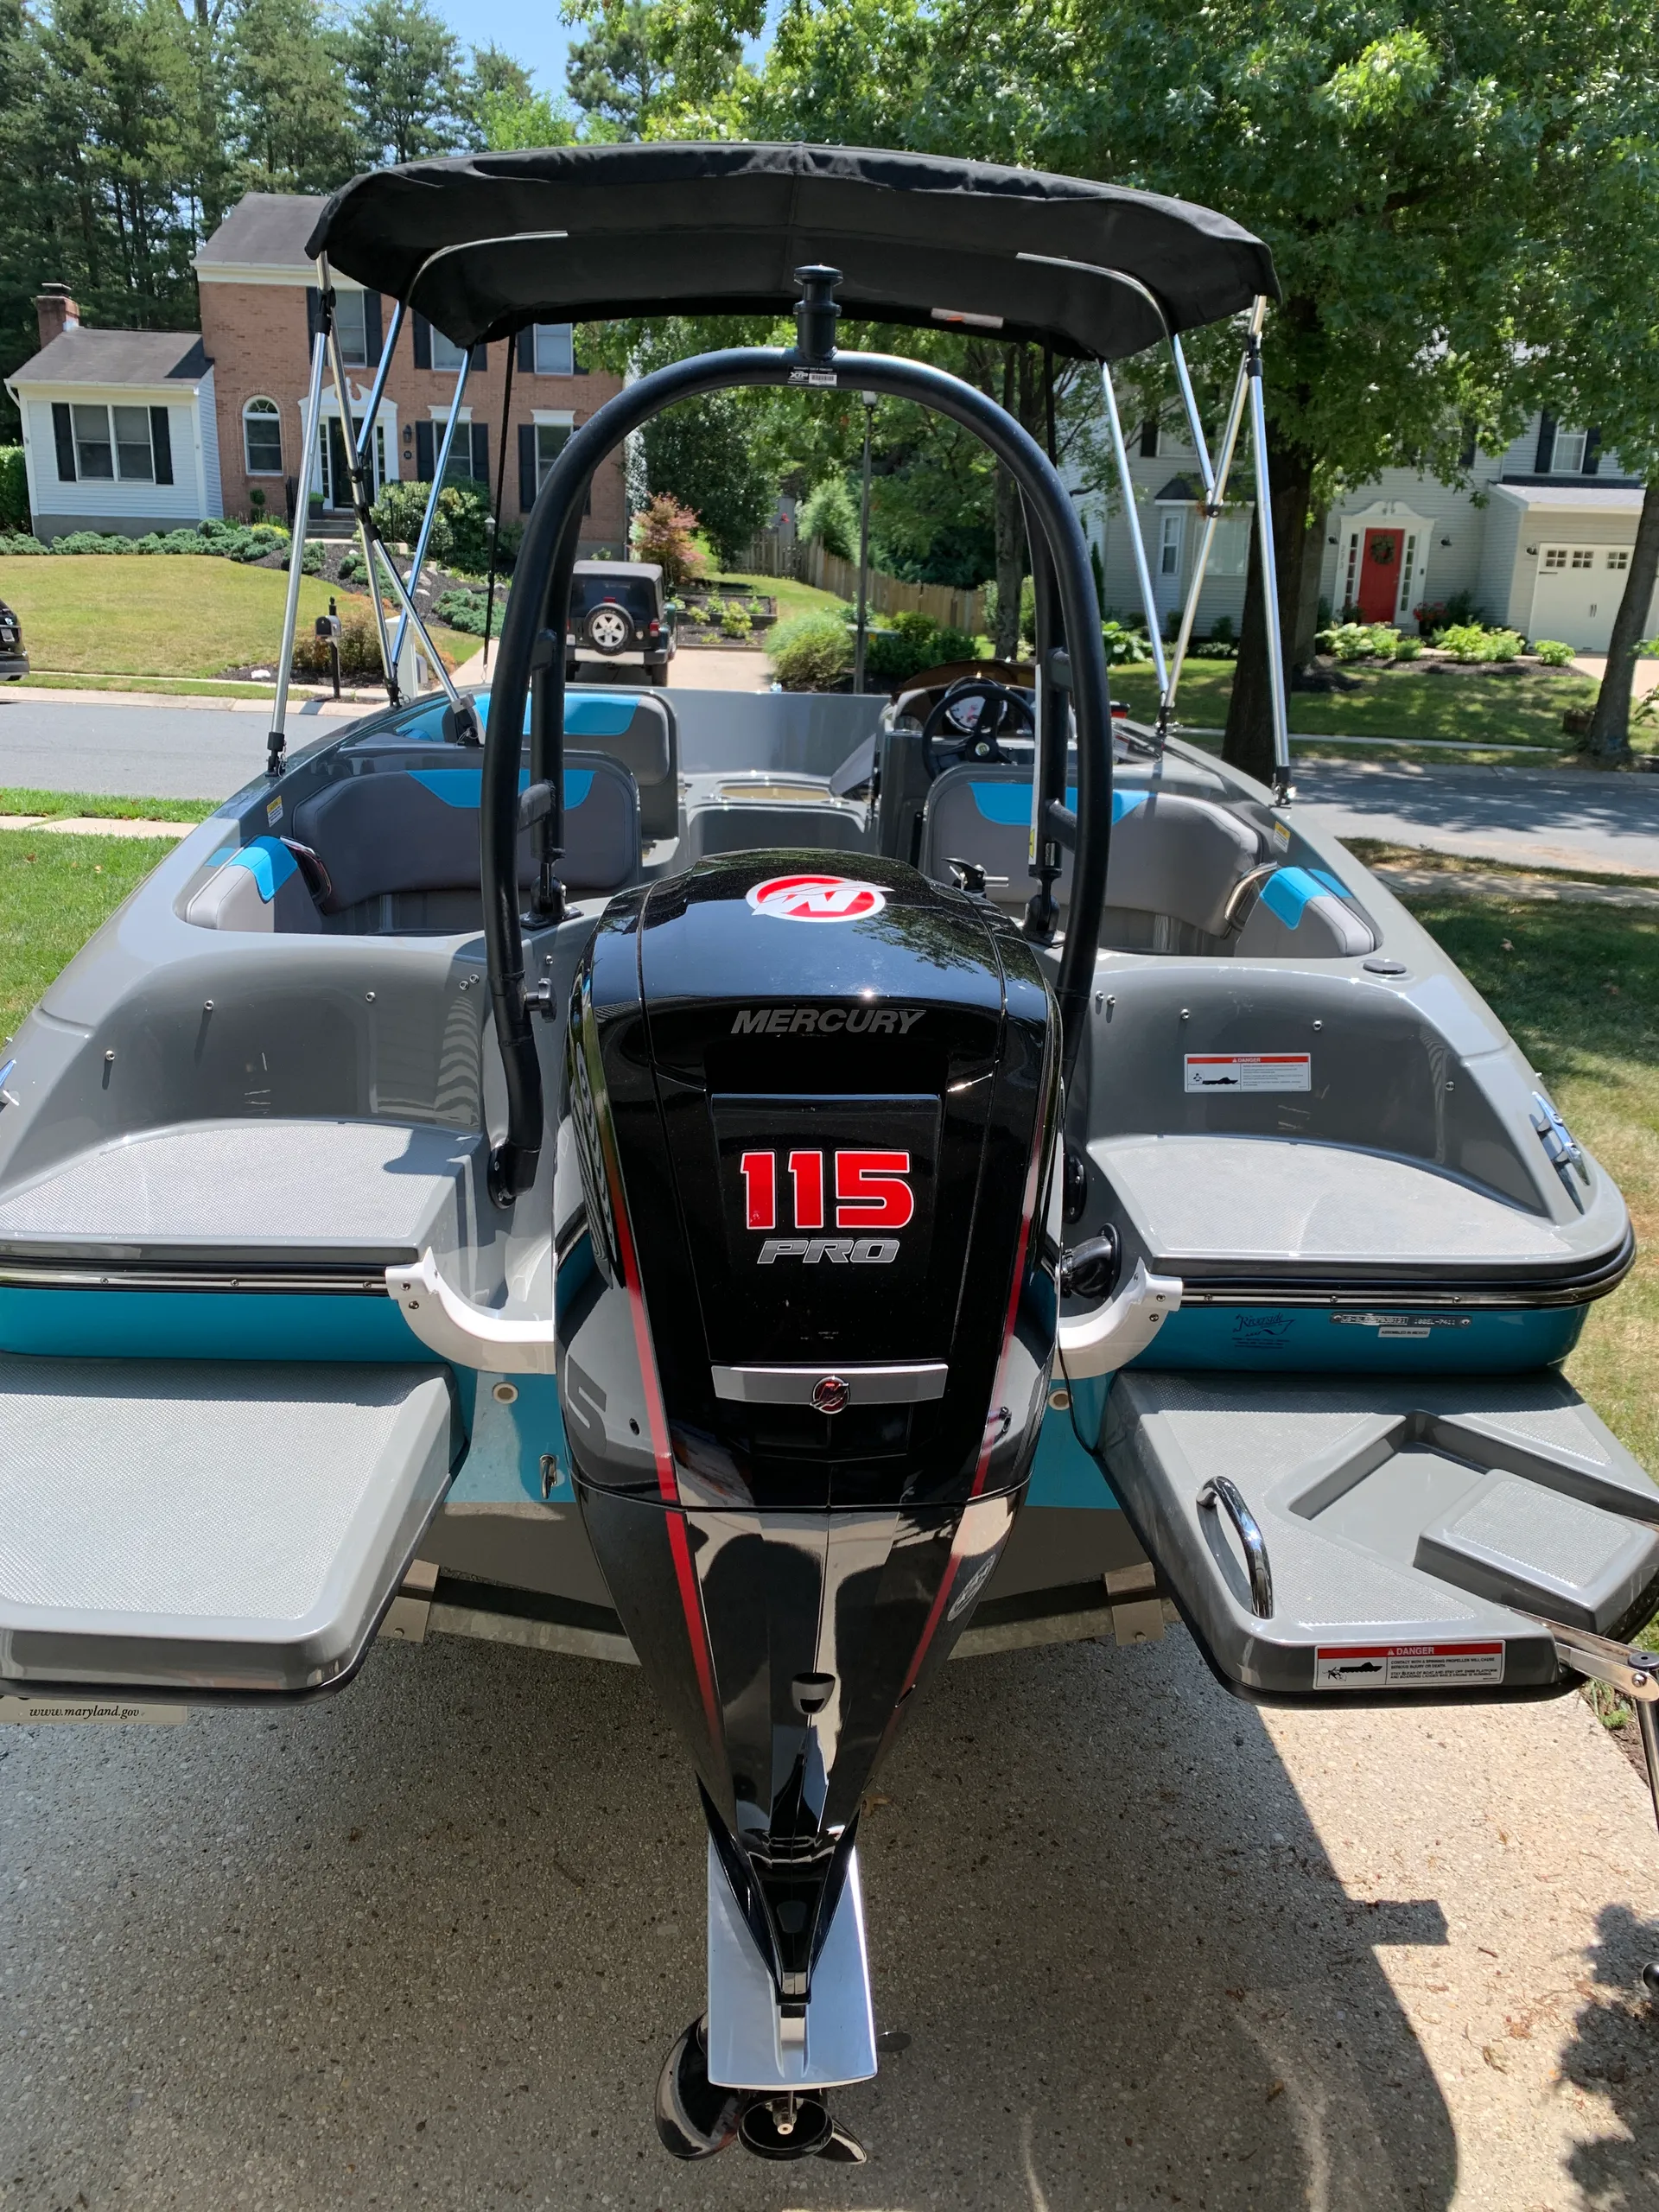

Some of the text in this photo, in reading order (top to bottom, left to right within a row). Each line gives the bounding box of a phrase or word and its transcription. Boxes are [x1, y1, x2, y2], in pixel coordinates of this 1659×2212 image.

[731, 1008, 926, 1034] MERCURY
[740, 1150, 914, 1230] 115
[756, 1239, 900, 1264] PRO
[1396, 1646, 1434, 1655] DANGER
[29, 1705, 139, 1719] www.maryland.gov
